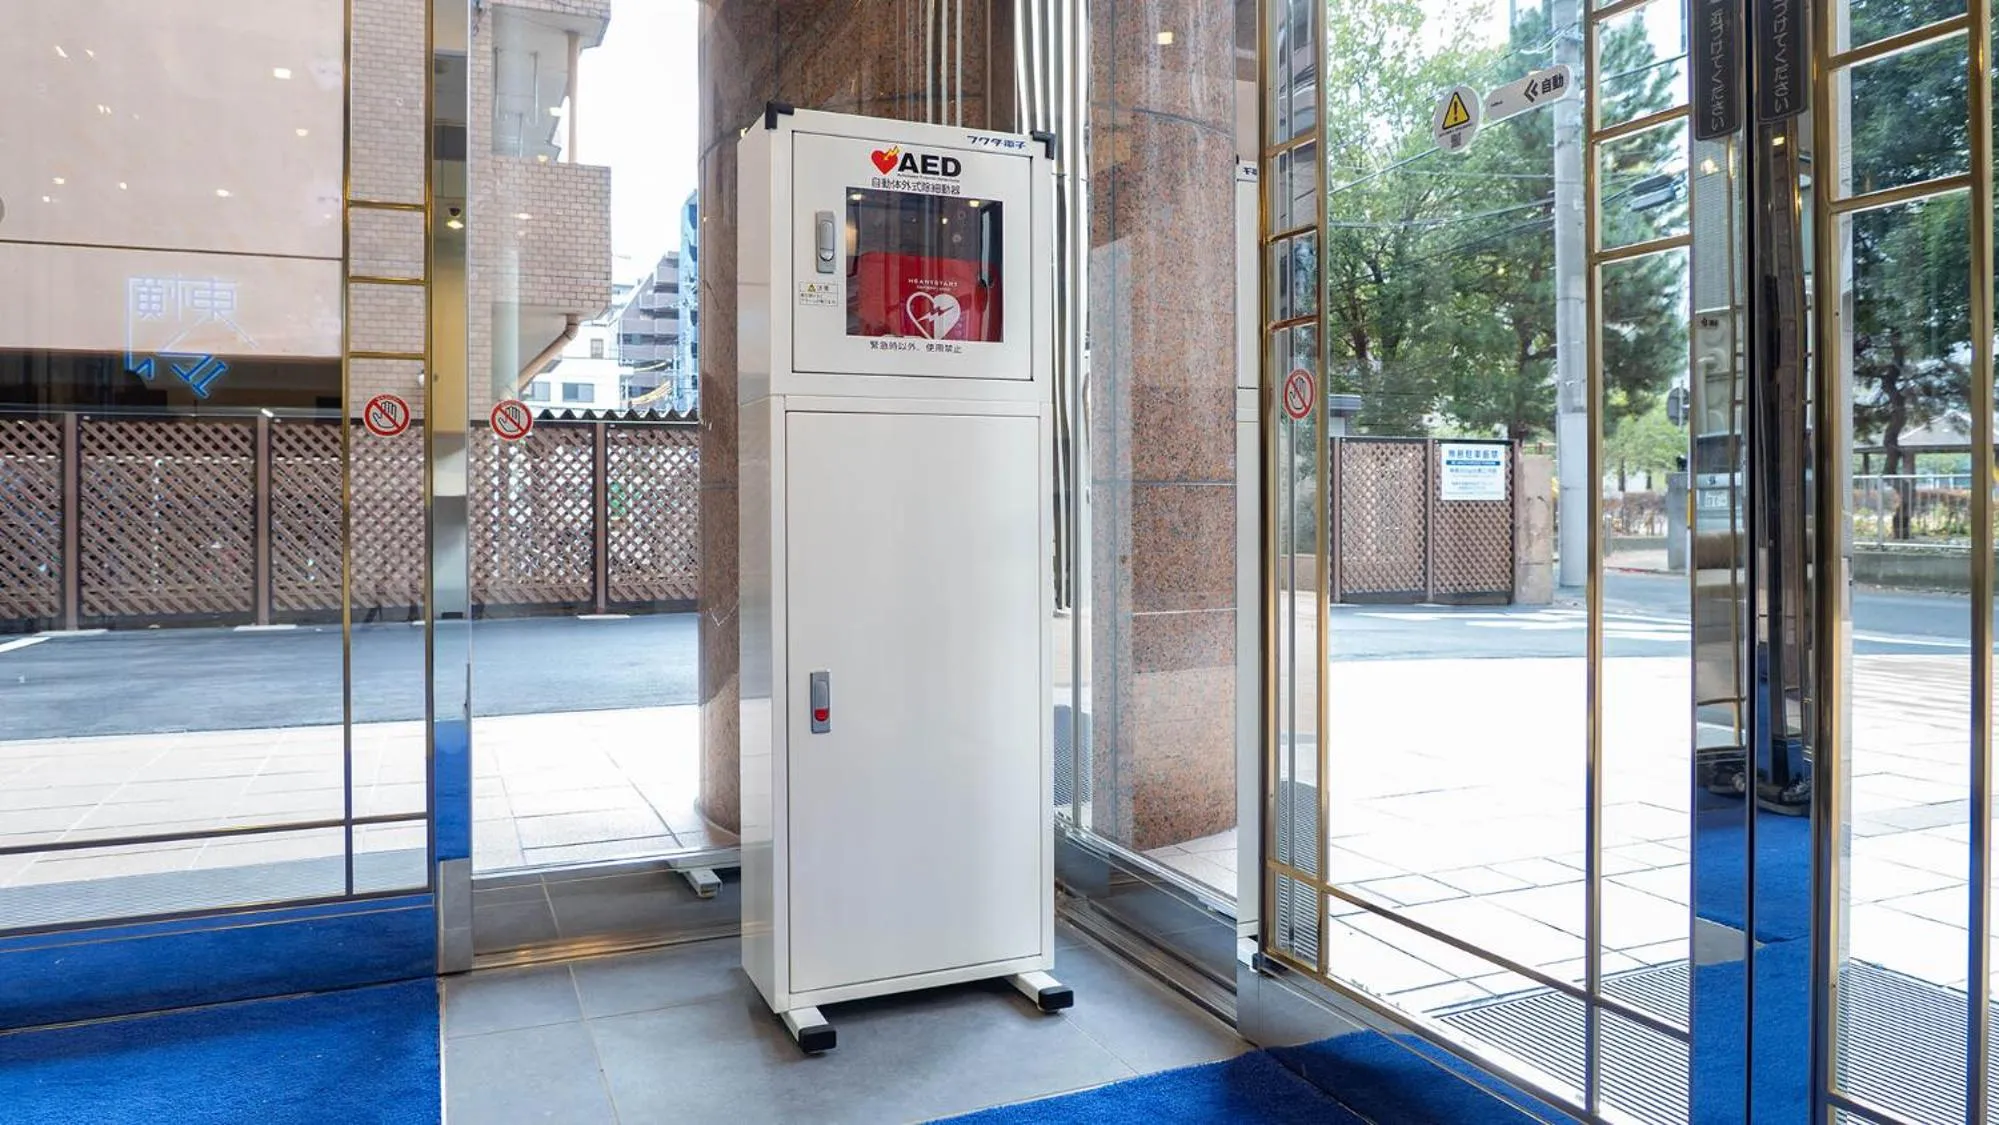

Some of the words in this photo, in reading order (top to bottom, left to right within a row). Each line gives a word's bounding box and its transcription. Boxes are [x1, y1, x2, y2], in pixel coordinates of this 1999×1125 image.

[1772, 0, 1790, 114] づけてください
[1541, 73, 1564, 94] 自動
[898, 152, 962, 177] AED
[871, 177, 961, 195] 自動体外式除細動器
